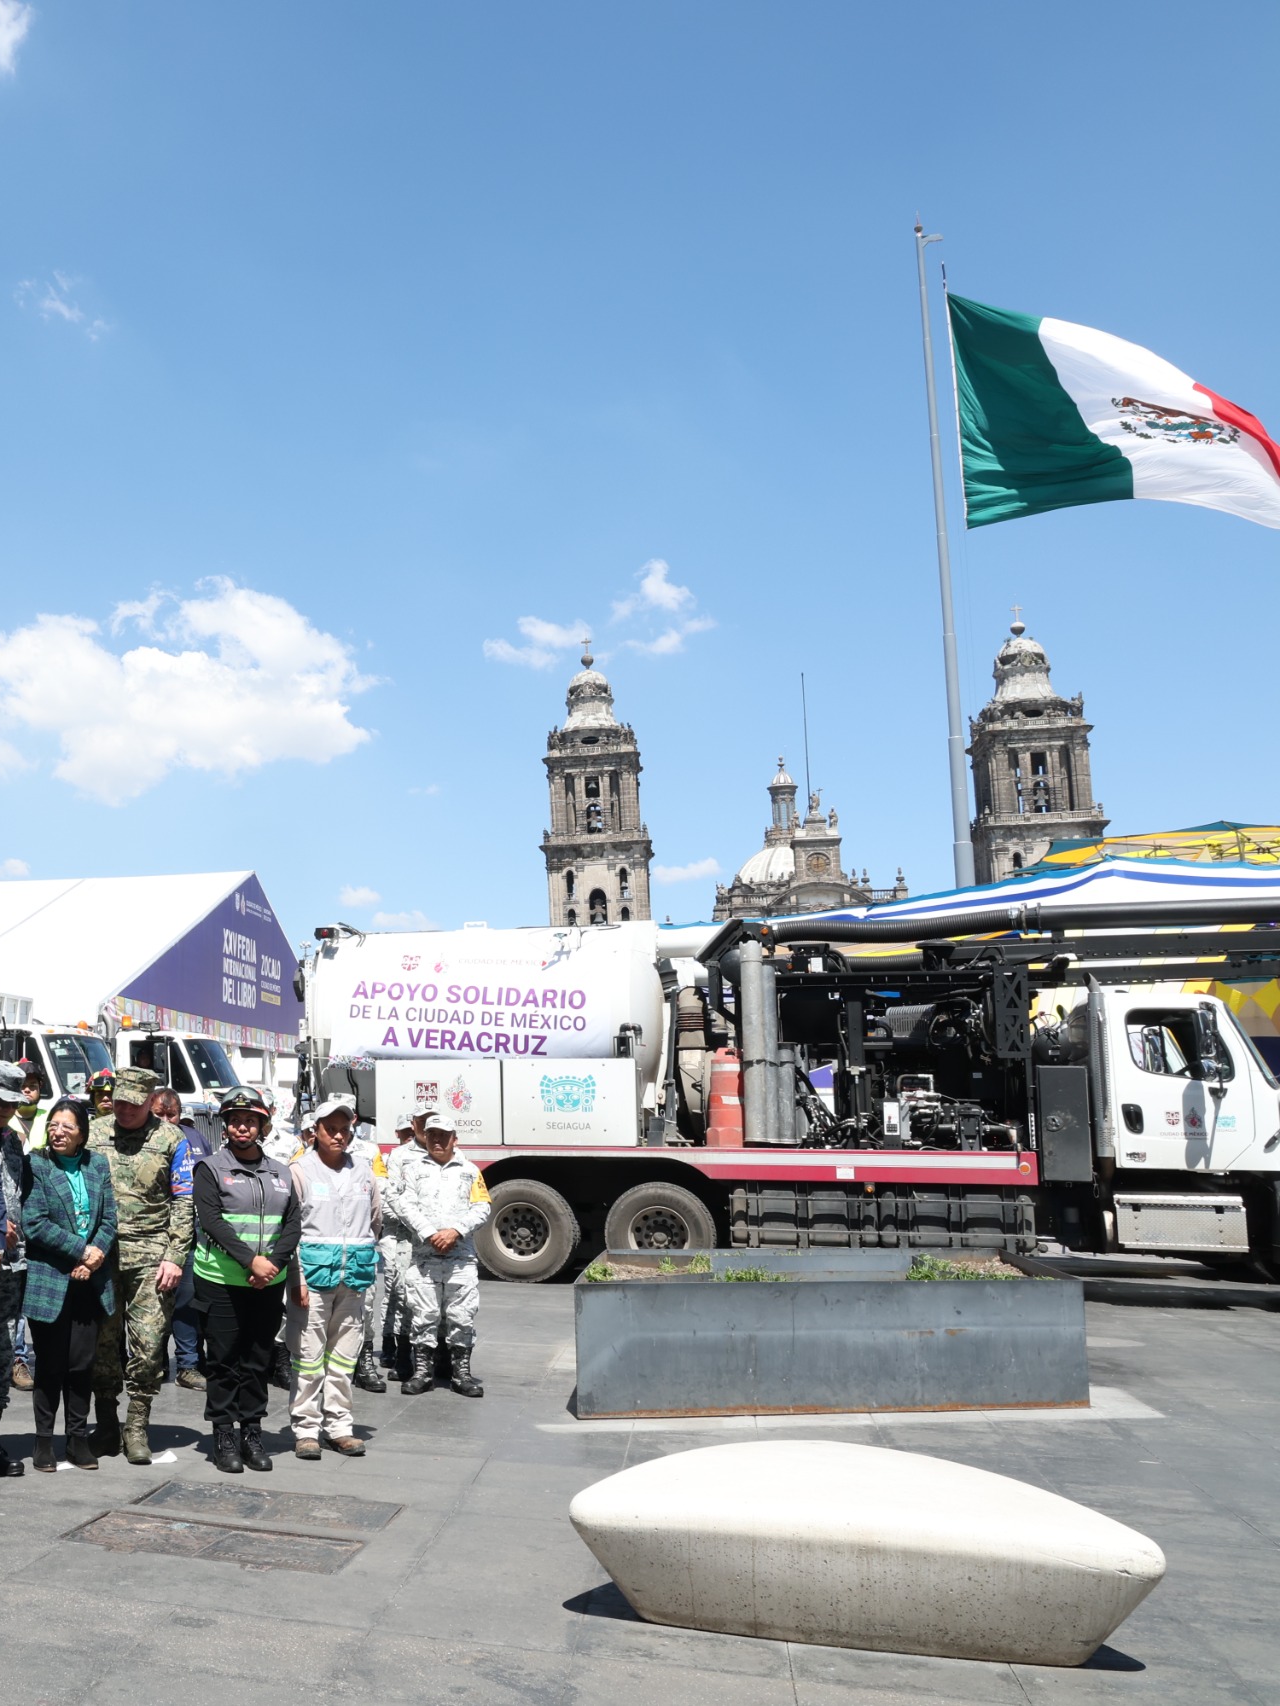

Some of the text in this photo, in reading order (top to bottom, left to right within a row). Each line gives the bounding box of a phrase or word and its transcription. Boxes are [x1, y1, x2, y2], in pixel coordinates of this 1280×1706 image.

[237, 933, 257, 964] FERIA
[223, 976, 257, 1009] DEL LIBRO
[352, 981, 586, 1010] APOYO SOLIDARIO
[349, 1004, 586, 1031] DE LA CIUDAD DE MÉXICO
[381, 1026, 547, 1056] A VERACRUZ
[546, 1121, 591, 1130] SEGIAGUA
